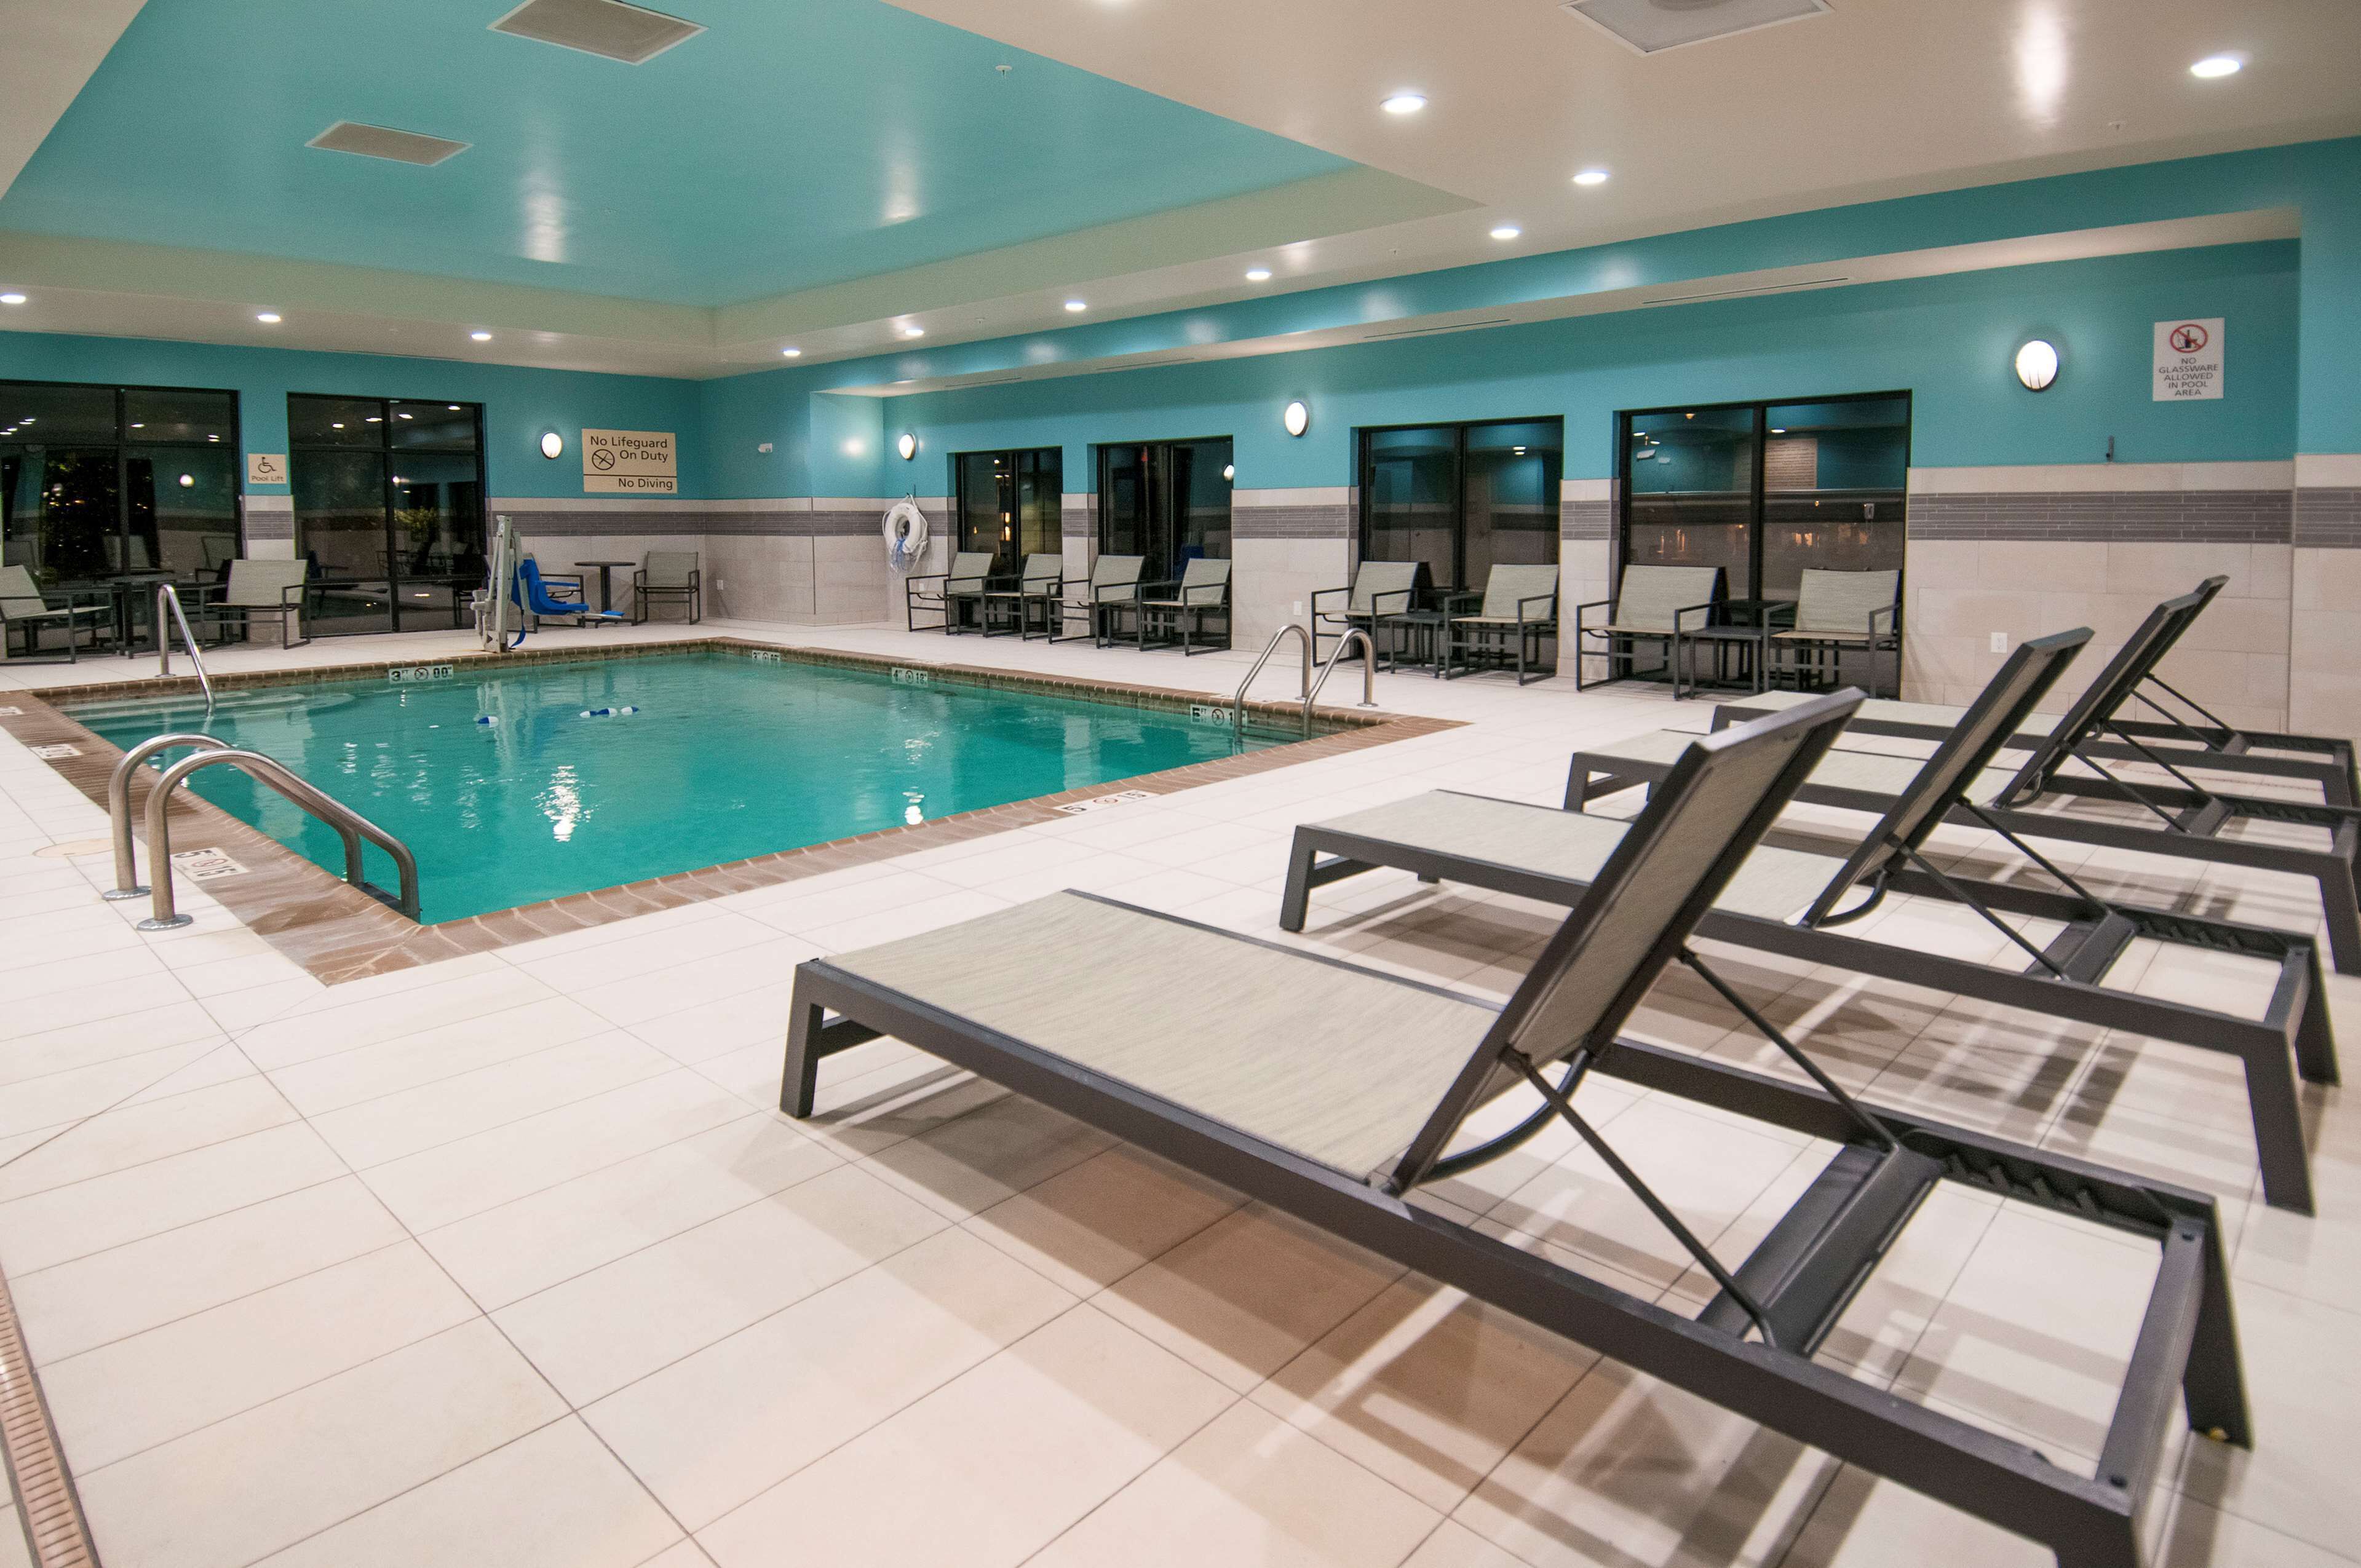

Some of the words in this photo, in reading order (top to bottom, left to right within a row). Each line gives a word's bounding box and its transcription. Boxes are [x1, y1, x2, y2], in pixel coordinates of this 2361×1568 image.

[2159, 364, 2218, 374] GLASSWARE
[2164, 373, 2213, 381] ALLOWED
[590, 436, 607, 446] No
[611, 437, 667, 449] Lifeguard
[619, 450, 637, 460] On
[641, 451, 668, 463] Duty
[618, 478, 634, 488] No
[638, 478, 673, 490] Diving
[391, 671, 401, 681] 3
[1192, 707, 1200, 718] 5
